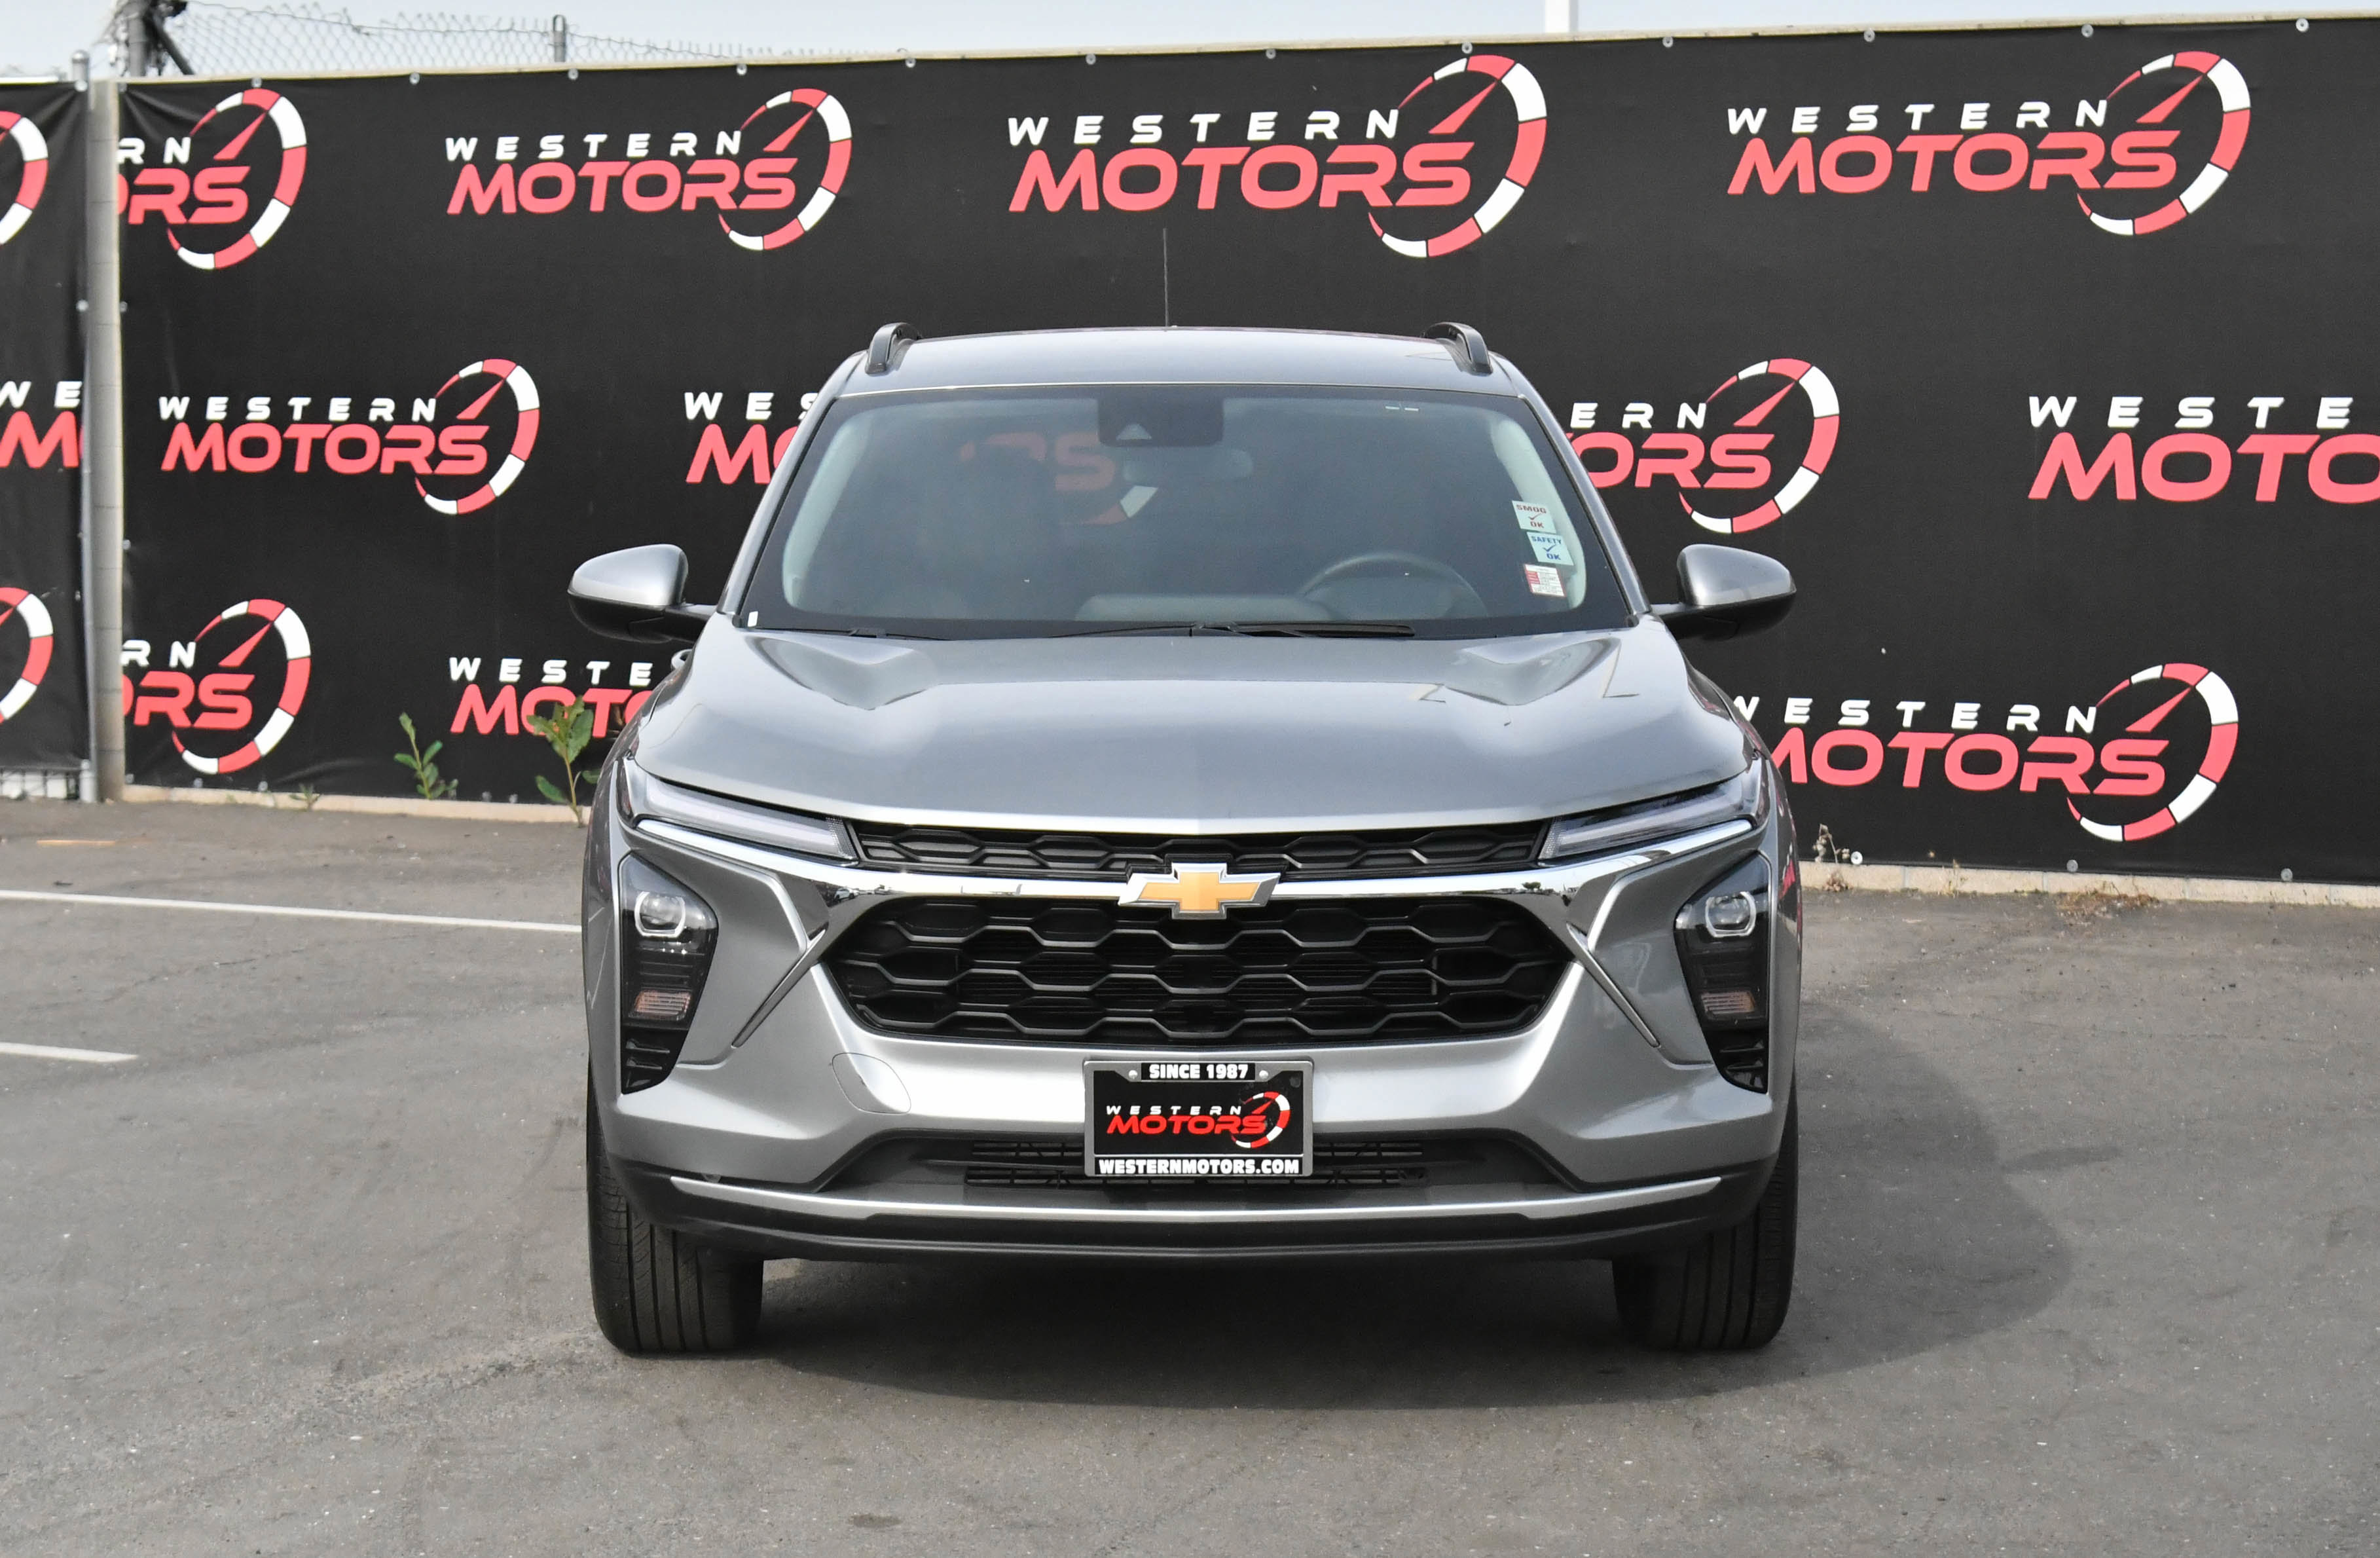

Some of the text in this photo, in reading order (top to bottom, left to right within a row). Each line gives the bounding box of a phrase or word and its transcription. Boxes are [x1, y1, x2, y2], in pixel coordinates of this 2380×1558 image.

[1008, 108, 1399, 145] WESTERN
[1727, 100, 2108, 135] WESTERN
[445, 130, 741, 161] WESTERN
[1009, 141, 1474, 213] MOTORS
[1727, 130, 2181, 195] MOTORS
[447, 157, 799, 215] MOTORS
[159, 396, 436, 422] WESTERN
[2028, 396, 2354, 430] WESTE
[161, 422, 490, 475] MOTORS
[1565, 431, 1775, 489] ORS
[1516, 504, 1547, 514] SMOG
[1530, 535, 1562, 545] SAFETY
[1148, 1064, 1249, 1079] SINCE 1987
[1106, 1105, 1241, 1115] WESTERN
[1106, 1115, 1266, 1135] MOTORS
[1099, 1159, 1300, 1176] WESTERNMOTORS.COM
